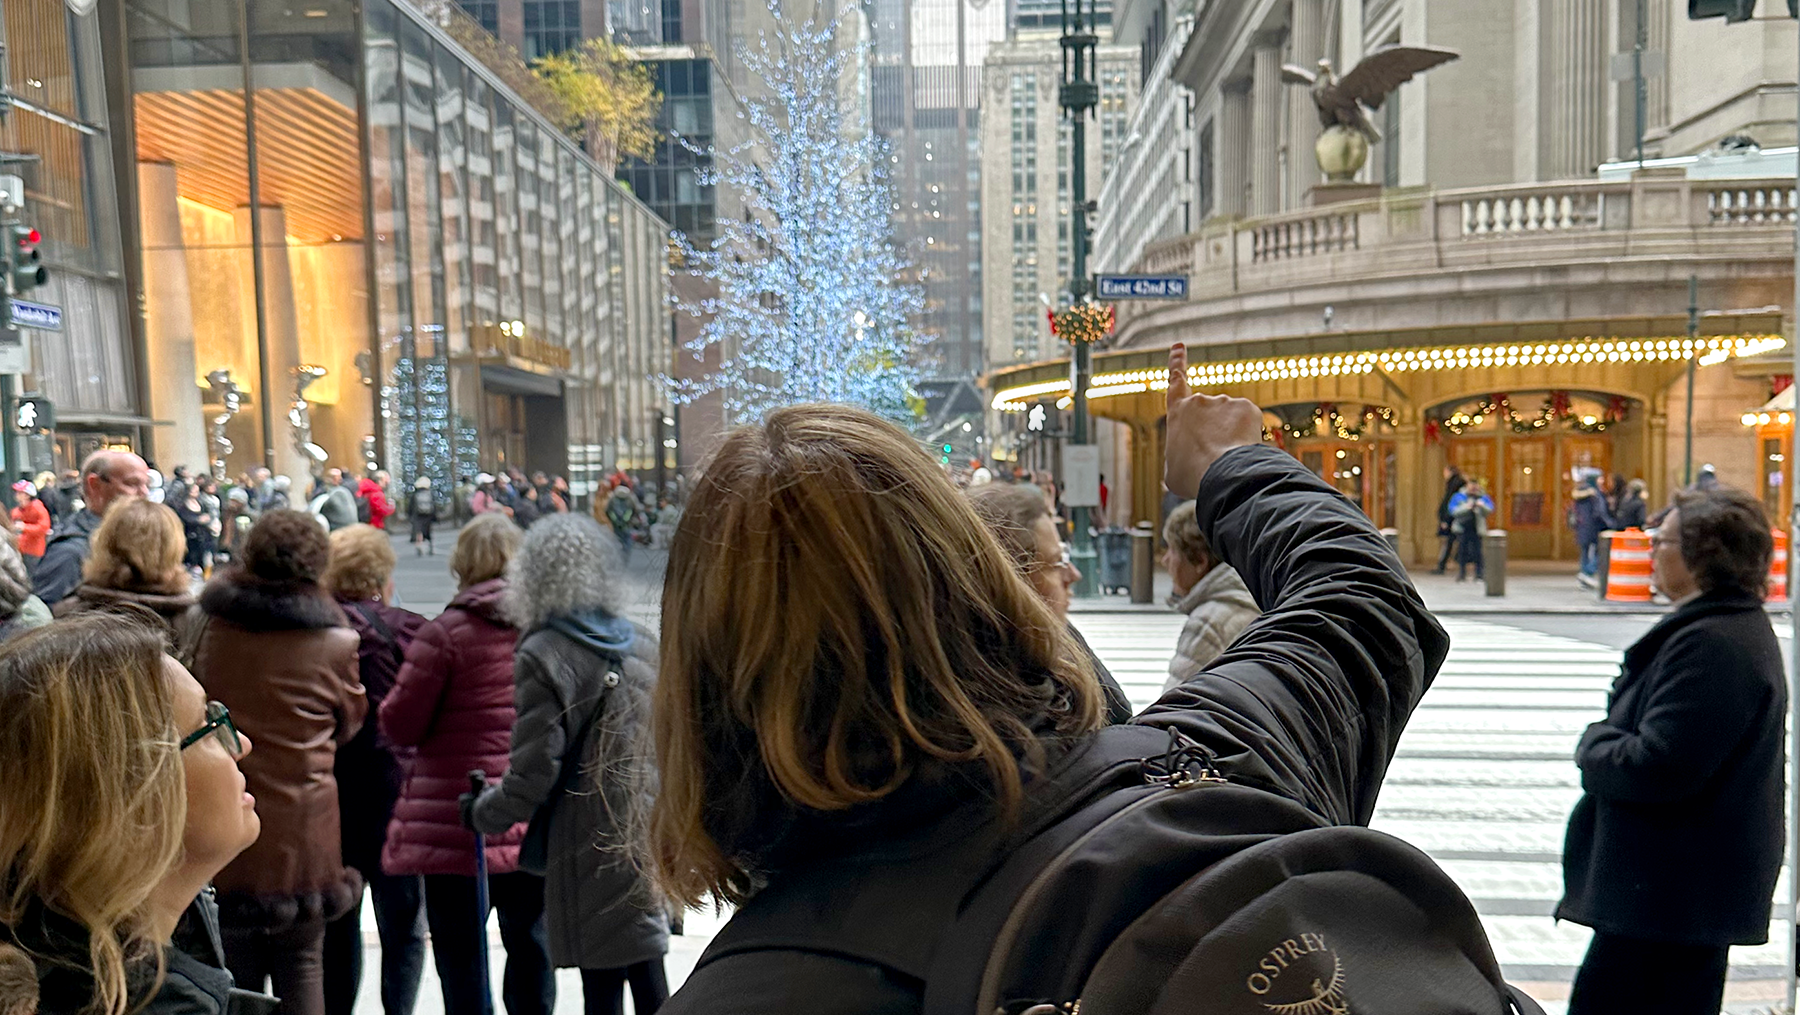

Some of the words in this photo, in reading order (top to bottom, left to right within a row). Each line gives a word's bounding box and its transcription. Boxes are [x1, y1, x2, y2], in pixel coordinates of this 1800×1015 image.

[1103, 280, 1131, 294] East
[1134, 280, 1166, 294] 42nd
[1167, 280, 1183, 295] St
[1247, 932, 1328, 994] OSPREY
